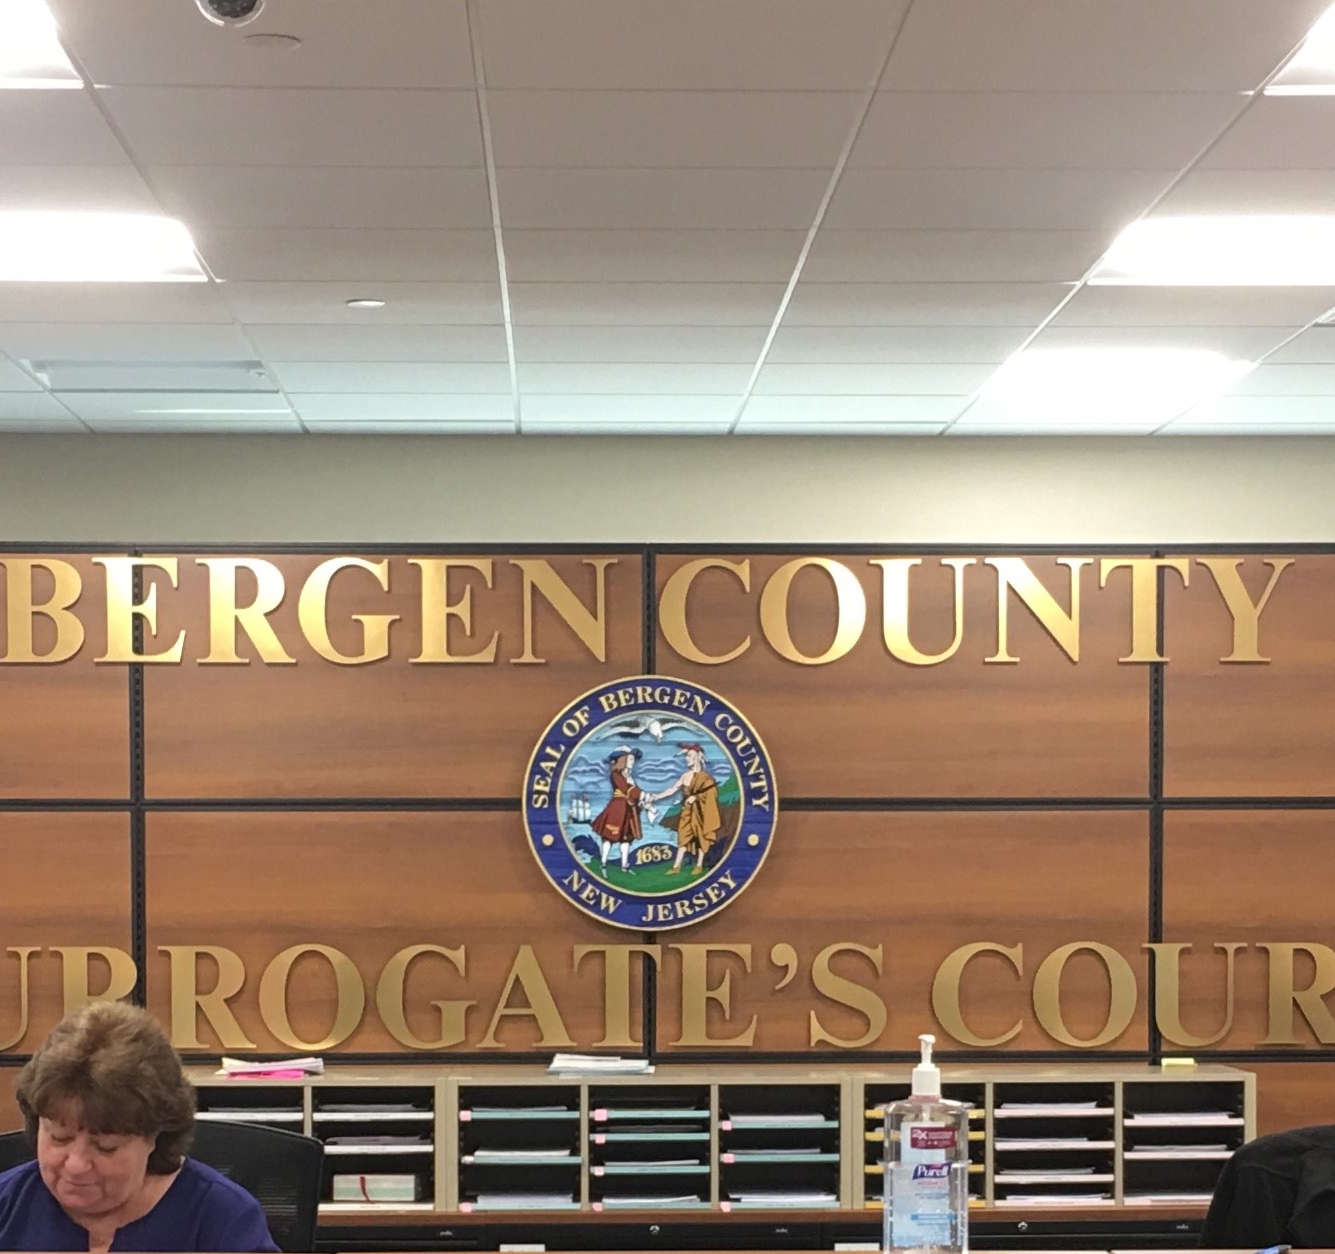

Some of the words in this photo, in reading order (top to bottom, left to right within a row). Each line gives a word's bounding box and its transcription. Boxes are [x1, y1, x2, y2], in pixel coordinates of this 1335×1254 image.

[658, 556, 1296, 666] COUNTY
[532, 742, 566, 809] SEAL
[561, 705, 591, 739] OF
[598, 685, 711, 717] BERGEN
[713, 712, 771, 812] COUNTY
[562, 869, 623, 916] NEW
[641, 870, 738, 922] JERSEY
[635, 845, 673, 865] 1683
